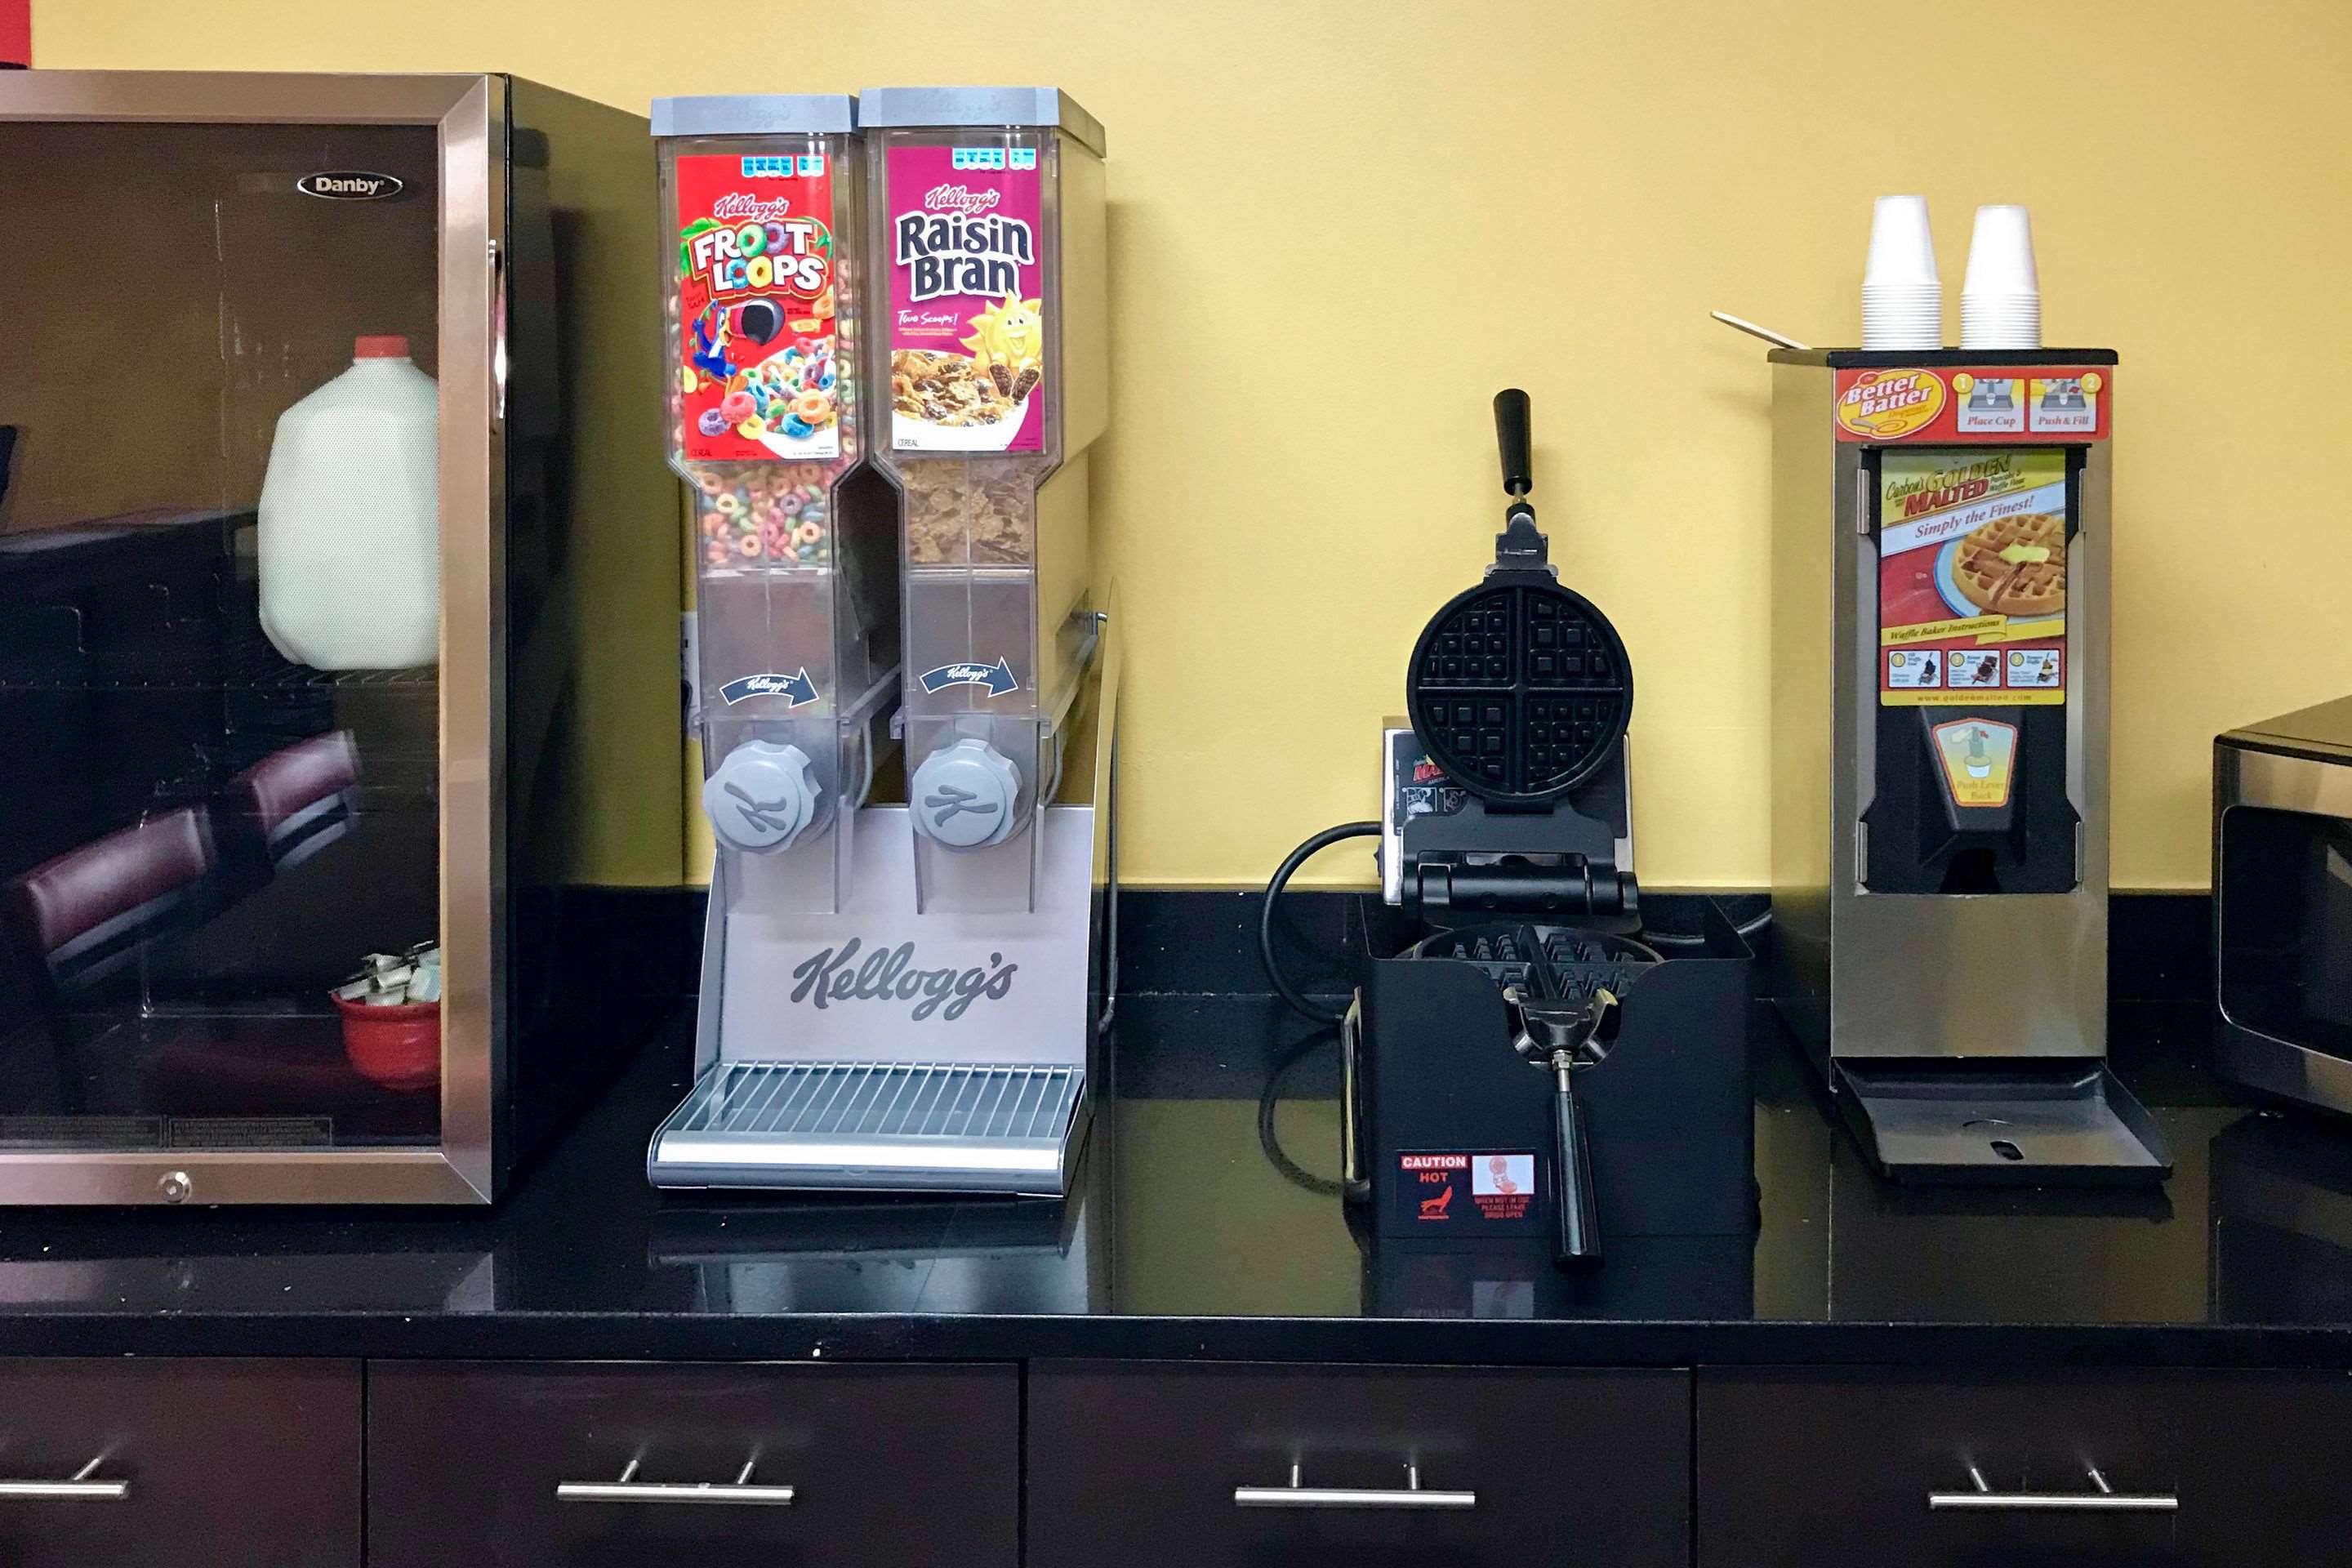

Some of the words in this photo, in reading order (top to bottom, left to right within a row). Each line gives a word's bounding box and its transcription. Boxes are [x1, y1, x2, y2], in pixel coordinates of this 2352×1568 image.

[316, 177, 379, 195] Danby
[926, 184, 1000, 213] Kellogg's
[715, 194, 789, 222] Kellogg's
[694, 222, 813, 270] FROOT
[900, 216, 1030, 261] Raisin
[713, 255, 823, 291] LOOPS
[915, 256, 1017, 297] Bran
[898, 310, 919, 325] Two
[920, 312, 959, 325] Scoops!
[1846, 374, 1919, 405] Better
[1860, 386, 1931, 416] Batter
[1967, 416, 1993, 425] Place
[1995, 416, 2016, 427] Cup
[2038, 416, 2061, 425] Push
[2062, 417, 2070, 425] &
[2072, 416, 2089, 425] Fill
[898, 439, 920, 447] CEREAL
[1904, 479, 1989, 516] MALTED
[1915, 515, 1962, 538] Simply
[1965, 510, 1986, 525] the
[1989, 496, 2035, 519] Finest!
[1891, 630, 1919, 640] Waffle
[1921, 627, 1946, 636] Baker
[1948, 620, 2001, 633] Instructions
[746, 676, 790, 693] Kellogg's
[947, 666, 989, 680] Kellogg's
[790, 937, 1018, 1022] Kellogg's
[1402, 1156, 1466, 1168] CAUTION
[1419, 1172, 1449, 1183] HOT
